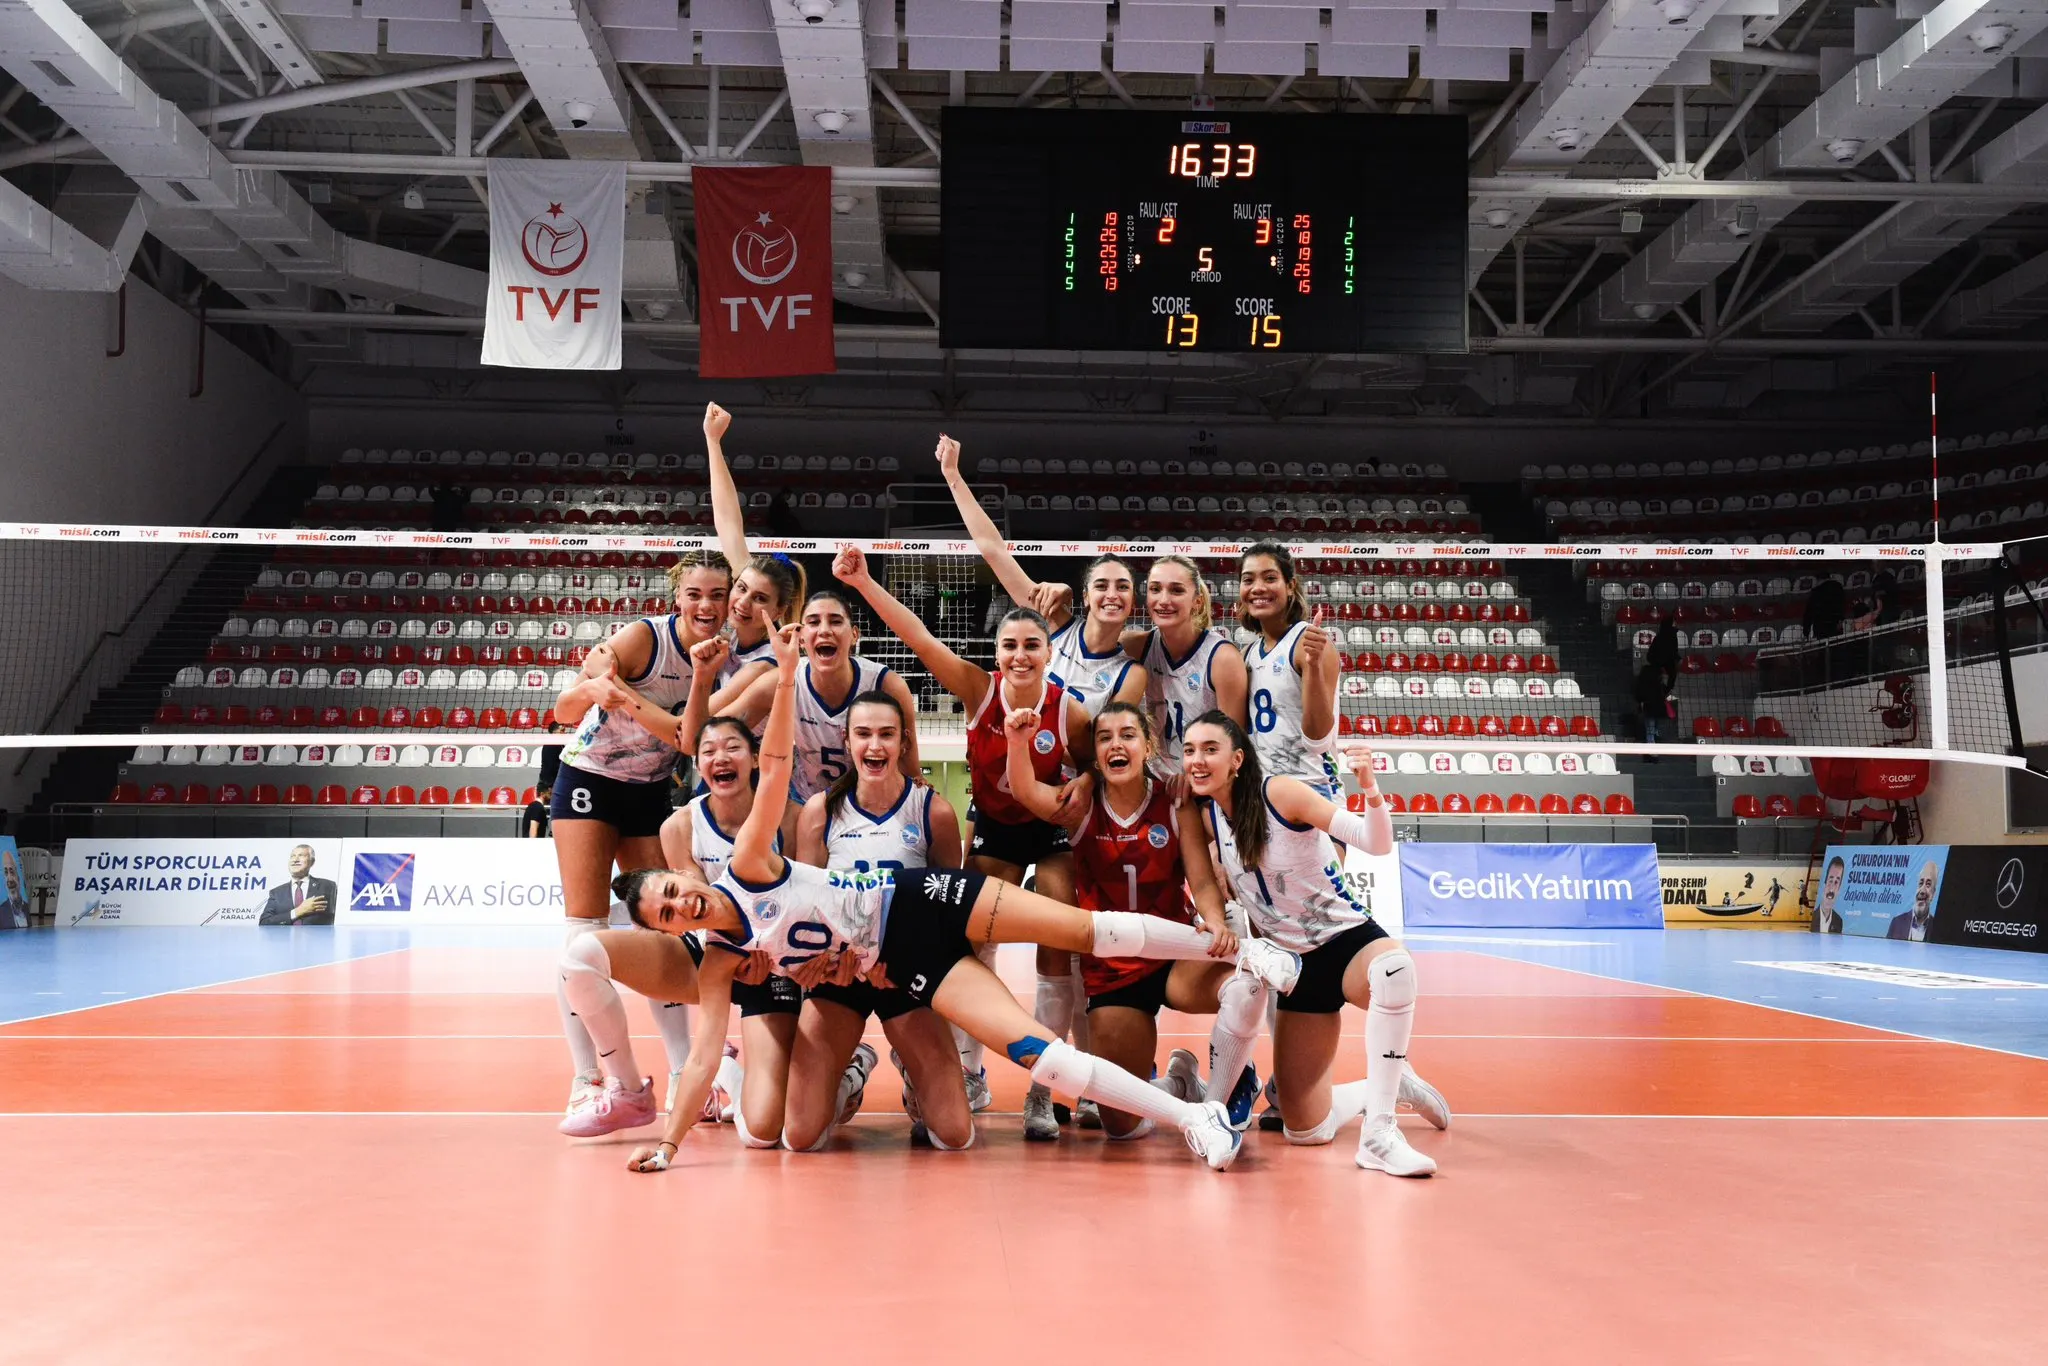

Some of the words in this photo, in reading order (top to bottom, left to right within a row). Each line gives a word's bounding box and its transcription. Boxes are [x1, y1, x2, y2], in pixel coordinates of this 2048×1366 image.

[1195, 175, 1220, 188] TIME
[1070, 212, 1074, 224] 1
[1139, 202, 1178, 219] FAUL/SET
[1233, 203, 1272, 220] FAUL/SET
[1105, 212, 1117, 225] 19
[1293, 214, 1311, 228] 25
[1349, 216, 1353, 228] 1
[1065, 228, 1074, 241] 2
[1100, 228, 1117, 242] 25
[1159, 218, 1175, 242] 2
[1255, 219, 1271, 244] 3
[1298, 231, 1311, 244] 18
[1344, 231, 1353, 245] 2
[1065, 244, 1074, 258] 3
[1100, 244, 1117, 258] 25
[1298, 247, 1311, 261] 19
[1345, 248, 1354, 261] 3
[1065, 261, 1074, 273] 4
[1100, 260, 1117, 274] 22
[1198, 247, 1213, 272] 5
[1190, 270, 1222, 282] PERIOD
[1293, 263, 1311, 277] 25
[1345, 264, 1354, 277] 4
[1065, 276, 1074, 290] 5
[1105, 277, 1117, 291] 13
[1298, 280, 1311, 293] 15
[1345, 280, 1354, 294] 5
[507, 285, 601, 323] TVF
[1151, 296, 1191, 315] SCORE
[1235, 297, 1275, 316] SCORE
[719, 294, 813, 332] TVF
[1166, 314, 1199, 347] 13
[1250, 315, 1282, 348] 15
[59, 528, 120, 537] misli.com
[178, 529, 239, 539] misli.com
[295, 532, 357, 541] misli.com
[375, 535, 395, 543] TVF
[412, 535, 473, 544] misli.com
[528, 537, 589, 546] misli.com
[643, 539, 703, 548] misli.com
[757, 540, 817, 549] misli.com
[871, 541, 931, 551] misli.com
[948, 543, 967, 551] TVF
[1060, 544, 1080, 552] TVF
[1097, 544, 1156, 553] misli.com
[1172, 545, 1192, 553] TVF
[1209, 545, 1249, 553] misli.c
[1288, 546, 1304, 554] VF
[1321, 545, 1380, 555] misli.com
[1396, 547, 1416, 555] TVF
[1432, 546, 1491, 555] misli.com
[1508, 547, 1528, 555] TVF
[1544, 546, 1602, 556] misli.com
[1619, 548, 1639, 556] TVF
[1655, 546, 1714, 556] misli.com
[1730, 547, 1750, 556] TVF
[1767, 546, 1825, 556] misli.com
[1842, 548, 1862, 556] TVF
[1879, 546, 1925, 556] misli.co
[1953, 547, 1973, 555] TVF
[820, 745, 848, 782] 5
[571, 787, 593, 814] 8
[85, 851, 128, 870] TÜM
[133, 854, 262, 871] SPORCULARA
[1852, 853, 1910, 868] ÇUKUROVA'NIN
[74, 876, 183, 895] BAŞARILAR
[187, 872, 267, 891] DİLERİM
[1428, 870, 1633, 902] GedikYatırım
[1658, 877, 1680, 888] POR
[1848, 871, 1906, 886] SULTANLARINA
[351, 882, 401, 907] AXA
[424, 884, 475, 906] AXA
[482, 880, 563, 906] SİGOR
[1123, 864, 1138, 912] 1
[1663, 889, 1708, 905] DANA
[1963, 919, 2038, 938] MERCEDES-EQ
